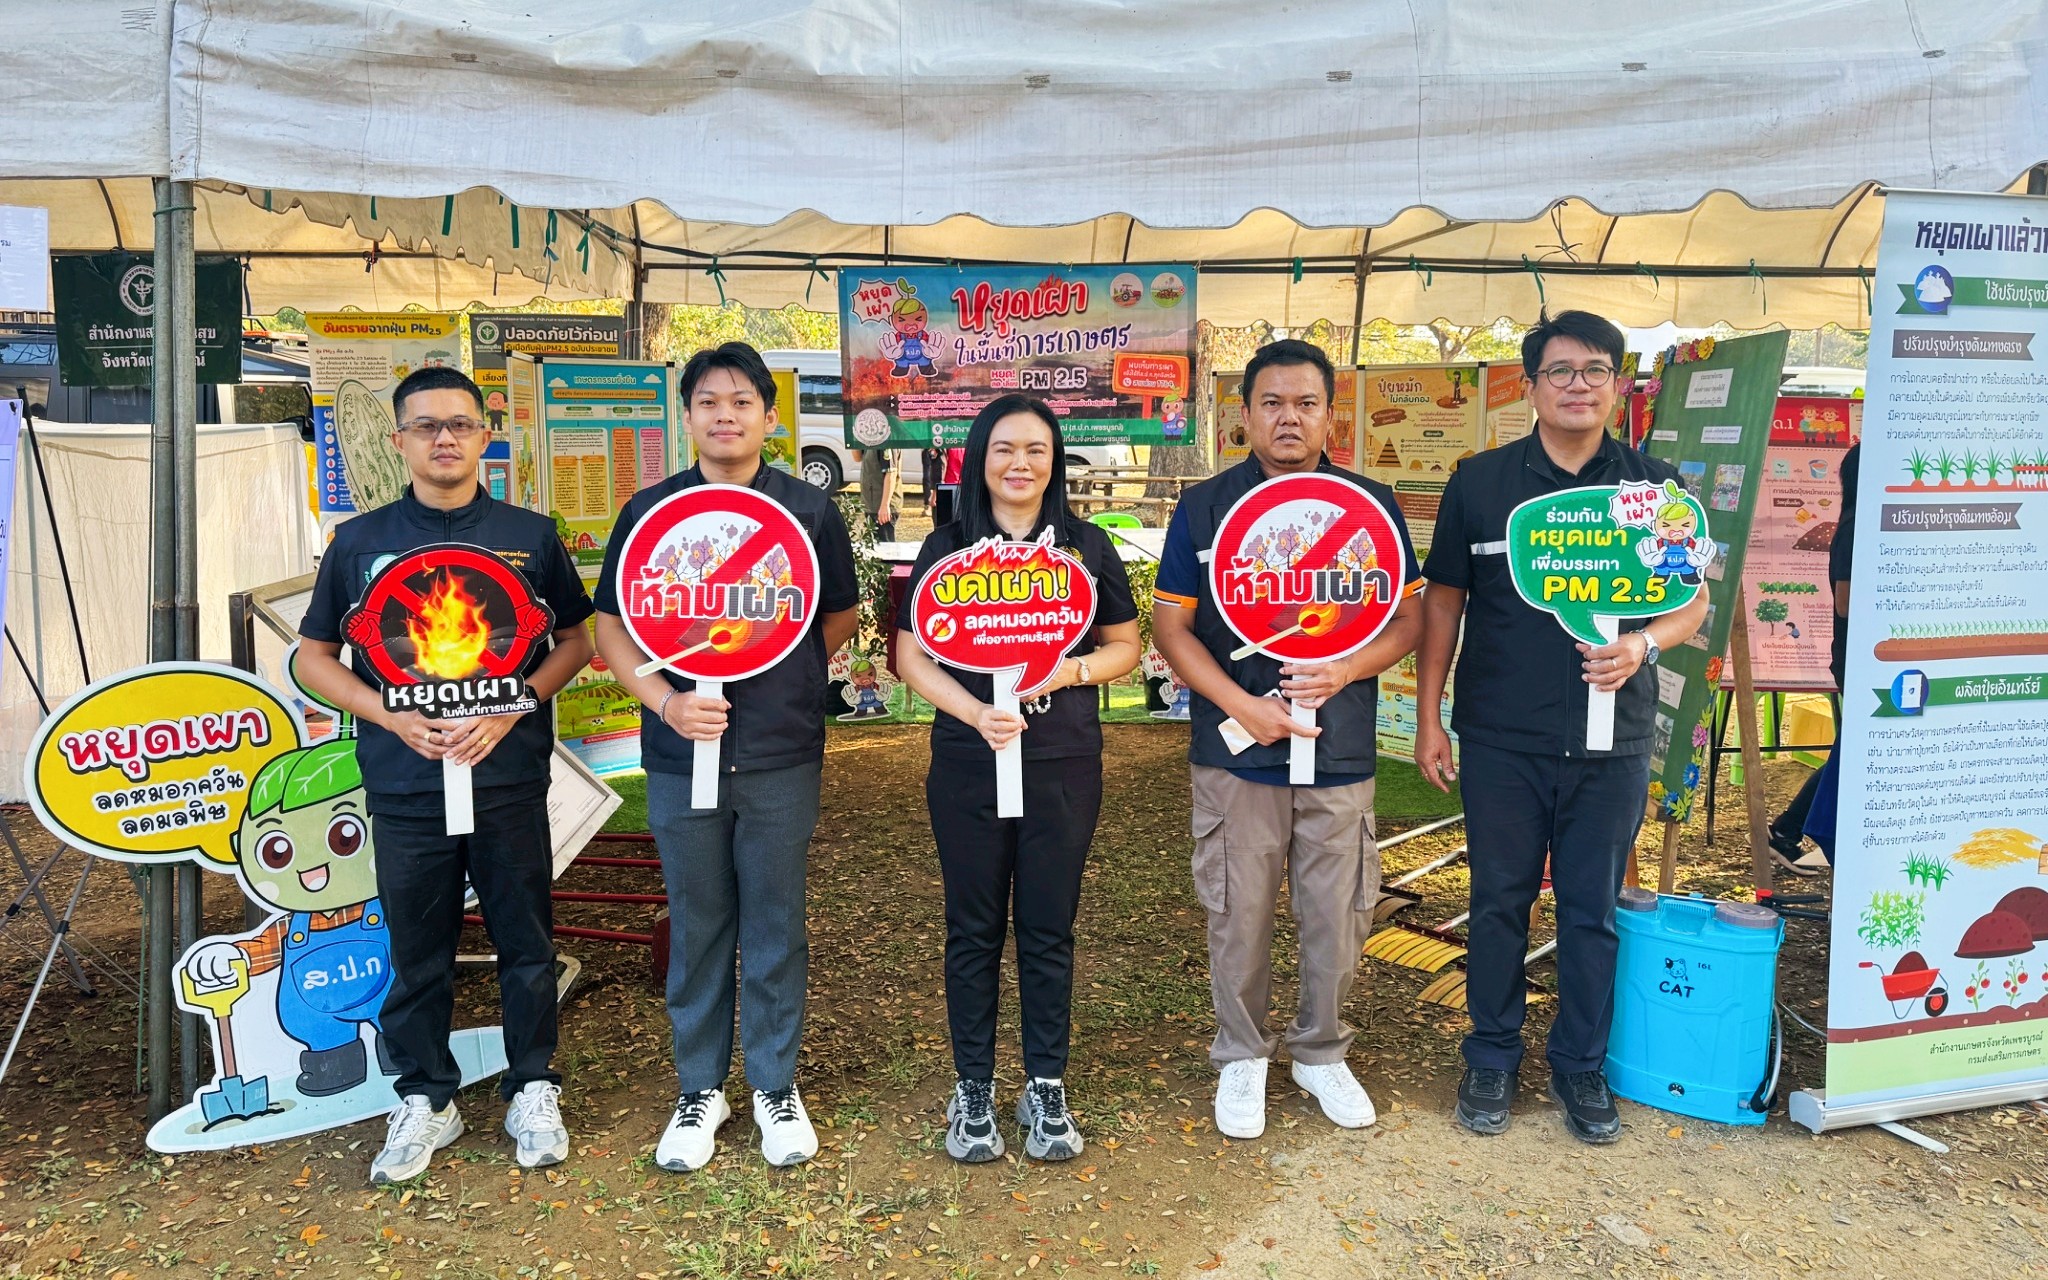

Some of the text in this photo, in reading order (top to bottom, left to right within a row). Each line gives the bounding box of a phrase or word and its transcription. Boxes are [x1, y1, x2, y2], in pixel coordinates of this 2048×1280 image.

[859, 286, 892, 304] หยุด
[866, 303, 891, 317] เผา
[951, 281, 1088, 338] หยุดเผา
[88, 323, 217, 345] สำนักงานสสุข
[323, 321, 441, 337] อันตรายจากฝุ่น PM2.5
[504, 325, 618, 342] ปลอดภัยไว้ก่อน!
[571, 343, 617, 354] ฉบับประชาชน
[954, 323, 1132, 366] ในพื้นที่การเกษตร
[1902, 336, 2022, 358] ปรับปรุงบำรุงดินทางตรง
[1020, 367, 1088, 390] PM 2.5
[1377, 377, 1423, 399] ปุ๋ยหมัก
[1389, 394, 1430, 404] ไม่กลับกอง
[1063, 433, 1131, 444] ที่ดินจังหวัดเพชรบูรณ์
[1619, 489, 1658, 508] หยุด
[1546, 507, 1602, 523] ร่วมกัน
[1626, 507, 1654, 521] เผา
[1891, 507, 2012, 530] ปรับปรุงบำรุงดินทางอ้อม
[1529, 528, 1627, 555] หยุดเผา
[1531, 551, 1620, 571] เพื่อบรรเทา
[932, 561, 1072, 605] งดเผา!
[1222, 555, 1392, 606] ห้ามเผา
[1543, 575, 1667, 603] PM 2.5
[629, 566, 805, 622] ห้ามเผา
[963, 609, 1084, 629] ลดหมอกควัน
[971, 627, 1067, 646] เพื่ออากาศบริสุทธิ์
[388, 677, 520, 713] หยุดเผา
[1955, 675, 2042, 703] ผลิตปุ๋ยอินทรีย์
[440, 698, 536, 719] ในพื้นที่การเกษตร
[62, 709, 266, 776] หยุดเผา
[1867, 746, 1883, 757] เช่น
[96, 769, 246, 810] ลดหมอกควัน
[120, 800, 228, 836] ลดมลพิษ
[303, 954, 382, 991] ส.ป.ก
[1659, 981, 1695, 998] CAT
[1930, 1030, 2044, 1056] สำนักงานเกษตรจังหวัดเพชรบูรณ์
[1967, 1047, 2042, 1065] กรมส่งเสริมการเกษตร
